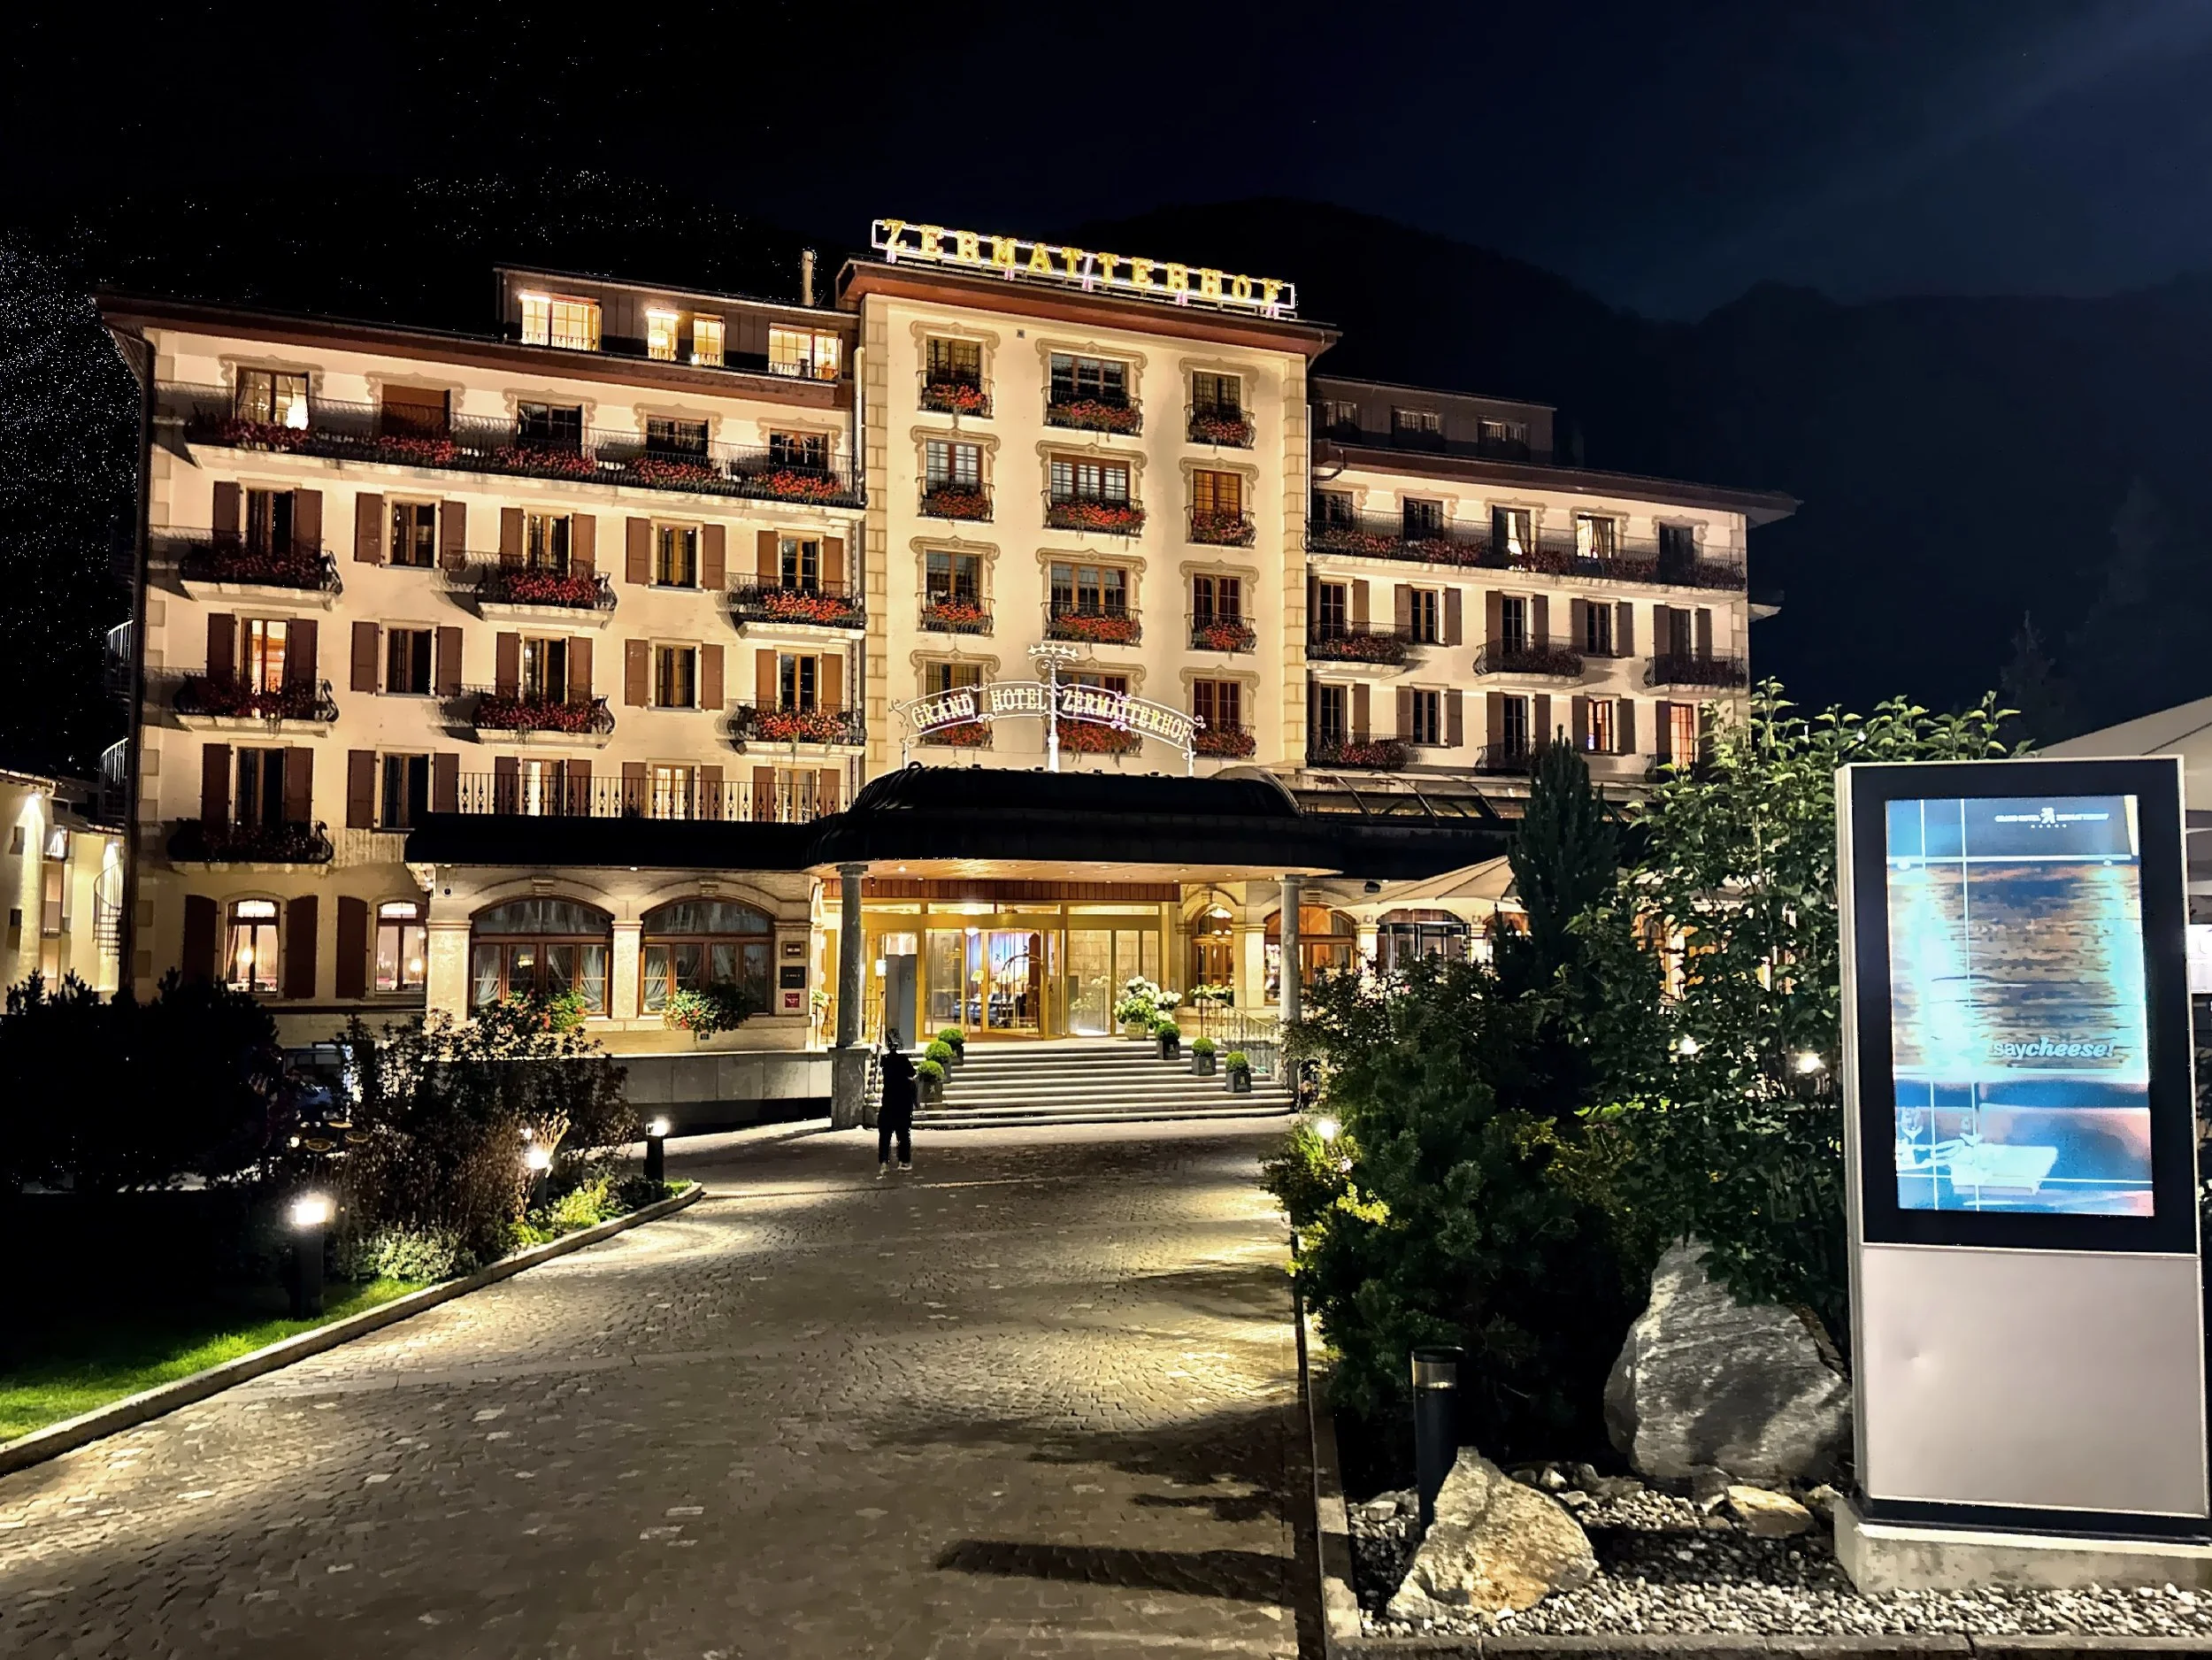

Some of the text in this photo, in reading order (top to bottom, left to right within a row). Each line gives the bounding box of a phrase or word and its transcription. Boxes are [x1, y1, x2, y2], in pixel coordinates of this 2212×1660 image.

[883, 219, 1284, 304] ZERMATTERHOF
[911, 688, 1192, 742] GRAND HOTEL ZERMATTERHOF
